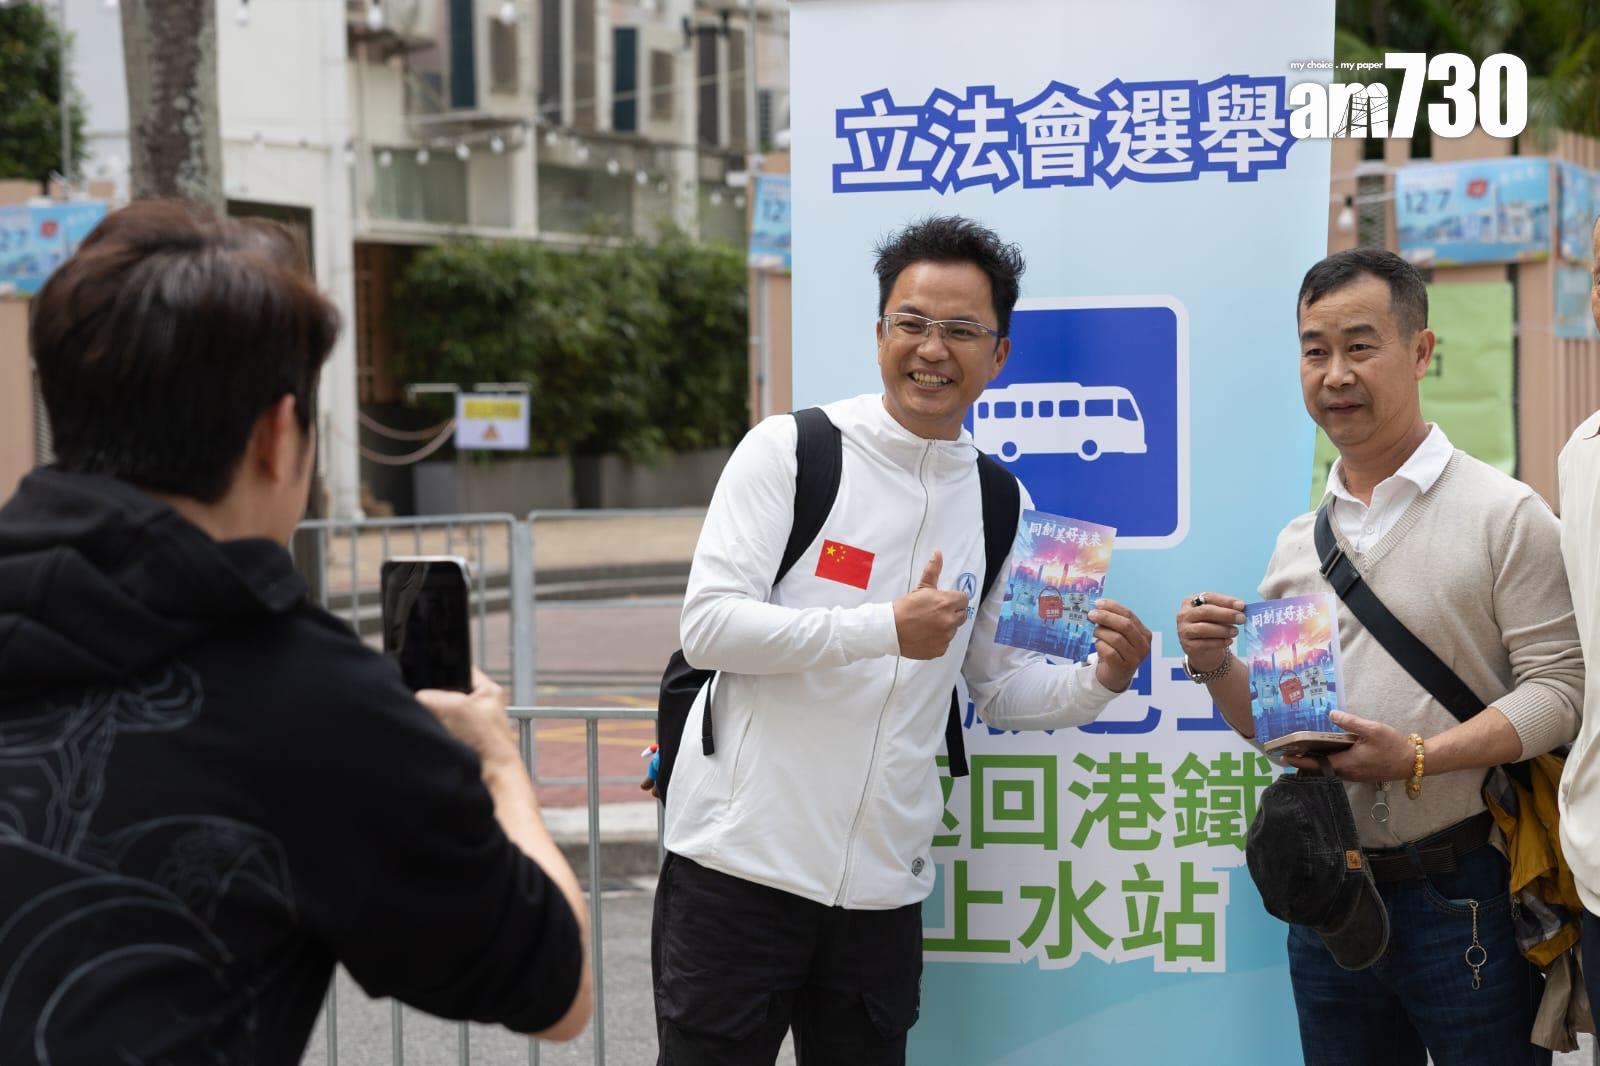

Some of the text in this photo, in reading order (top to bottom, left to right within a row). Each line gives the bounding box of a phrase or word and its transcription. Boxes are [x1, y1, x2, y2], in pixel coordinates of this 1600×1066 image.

[837, 79, 1290, 190] 立法會選舉
[1029, 521, 1103, 547] 同創美好未來
[1252, 603, 1320, 628] 同創美好未來
[922, 860, 1219, 963] 上水站
